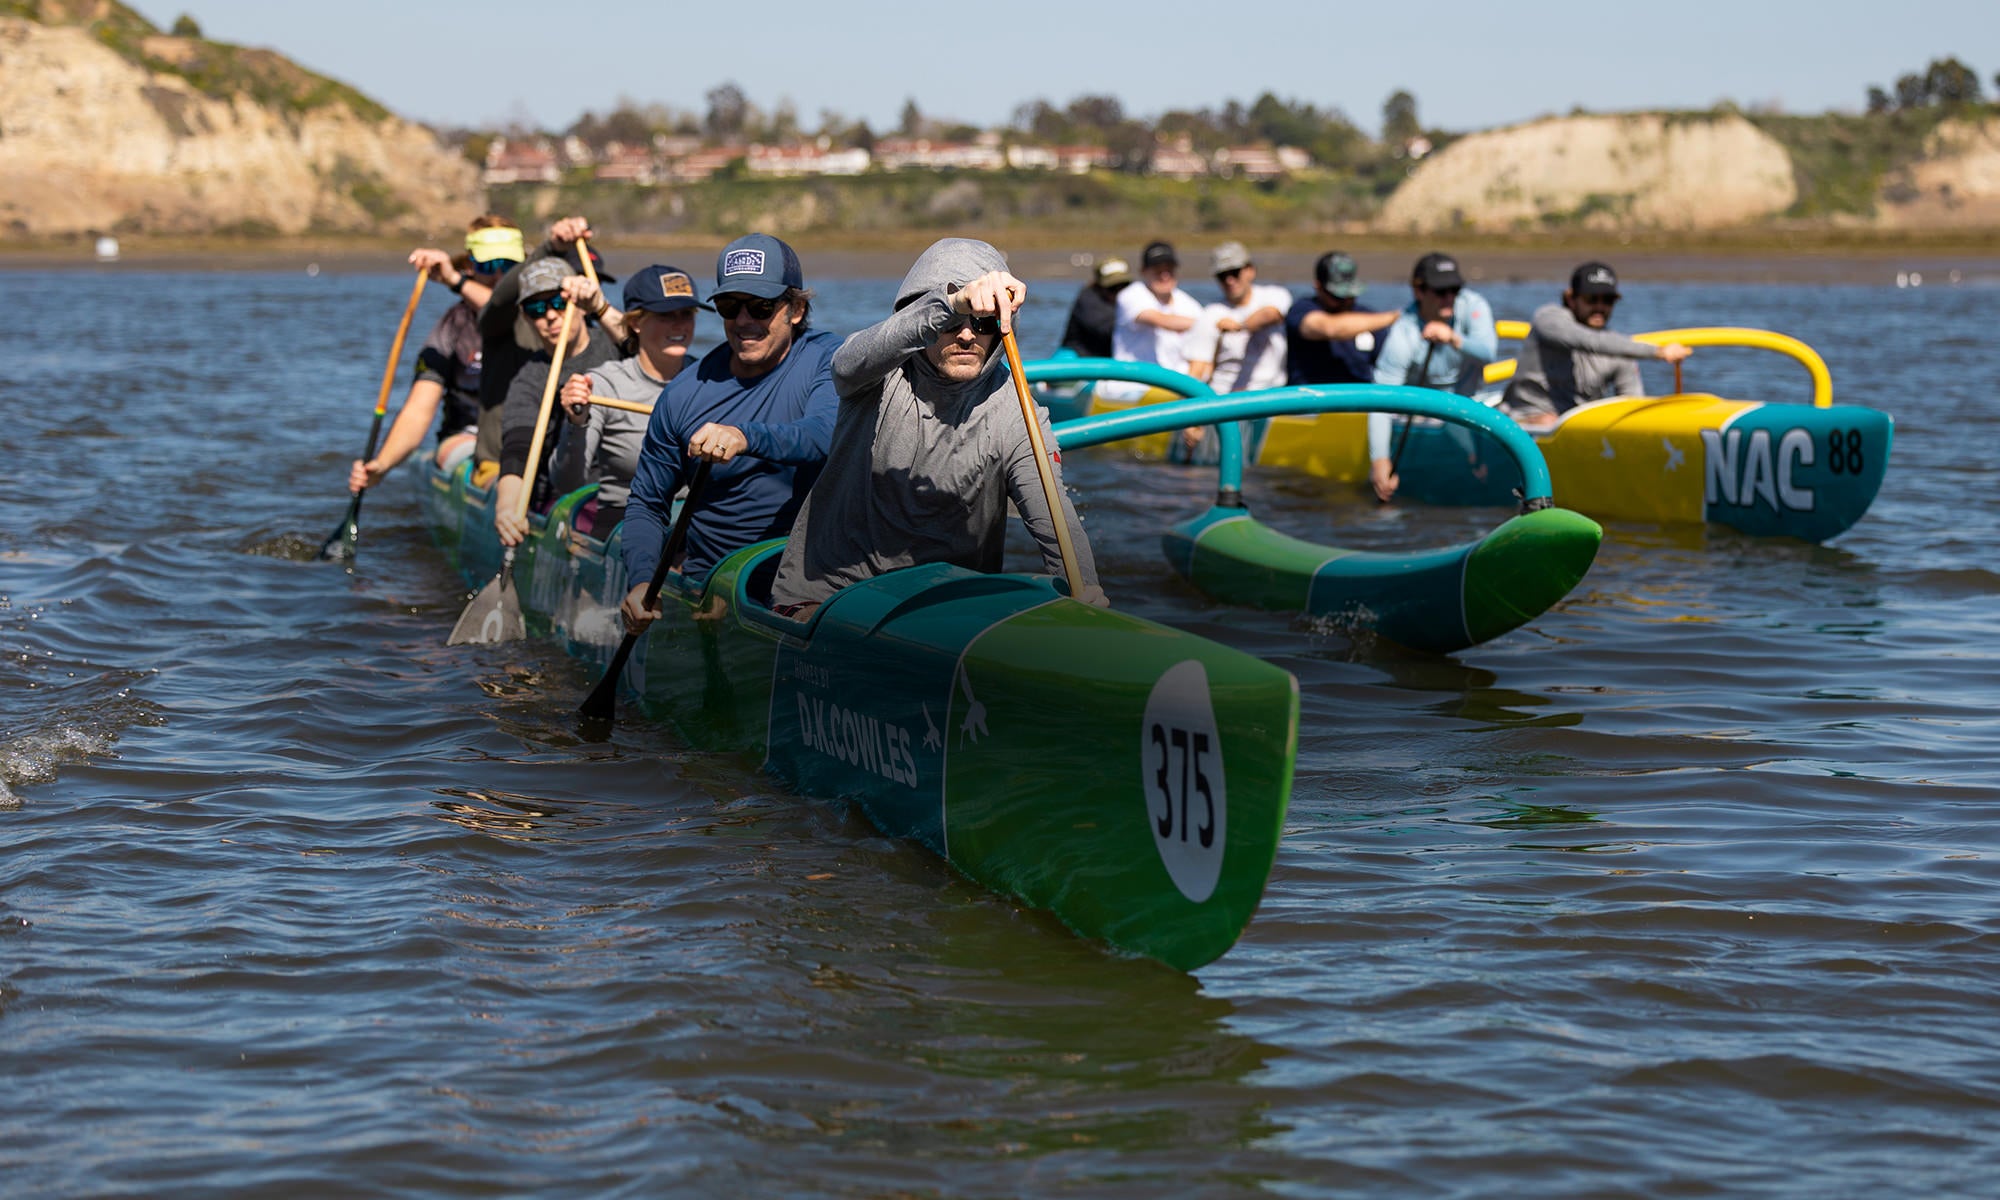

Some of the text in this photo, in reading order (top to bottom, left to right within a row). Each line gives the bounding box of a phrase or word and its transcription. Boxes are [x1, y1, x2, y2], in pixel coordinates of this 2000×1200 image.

[1700, 429, 1815, 515] NAC
[1829, 429, 1863, 475] 88
[1152, 723, 1215, 848] 375
